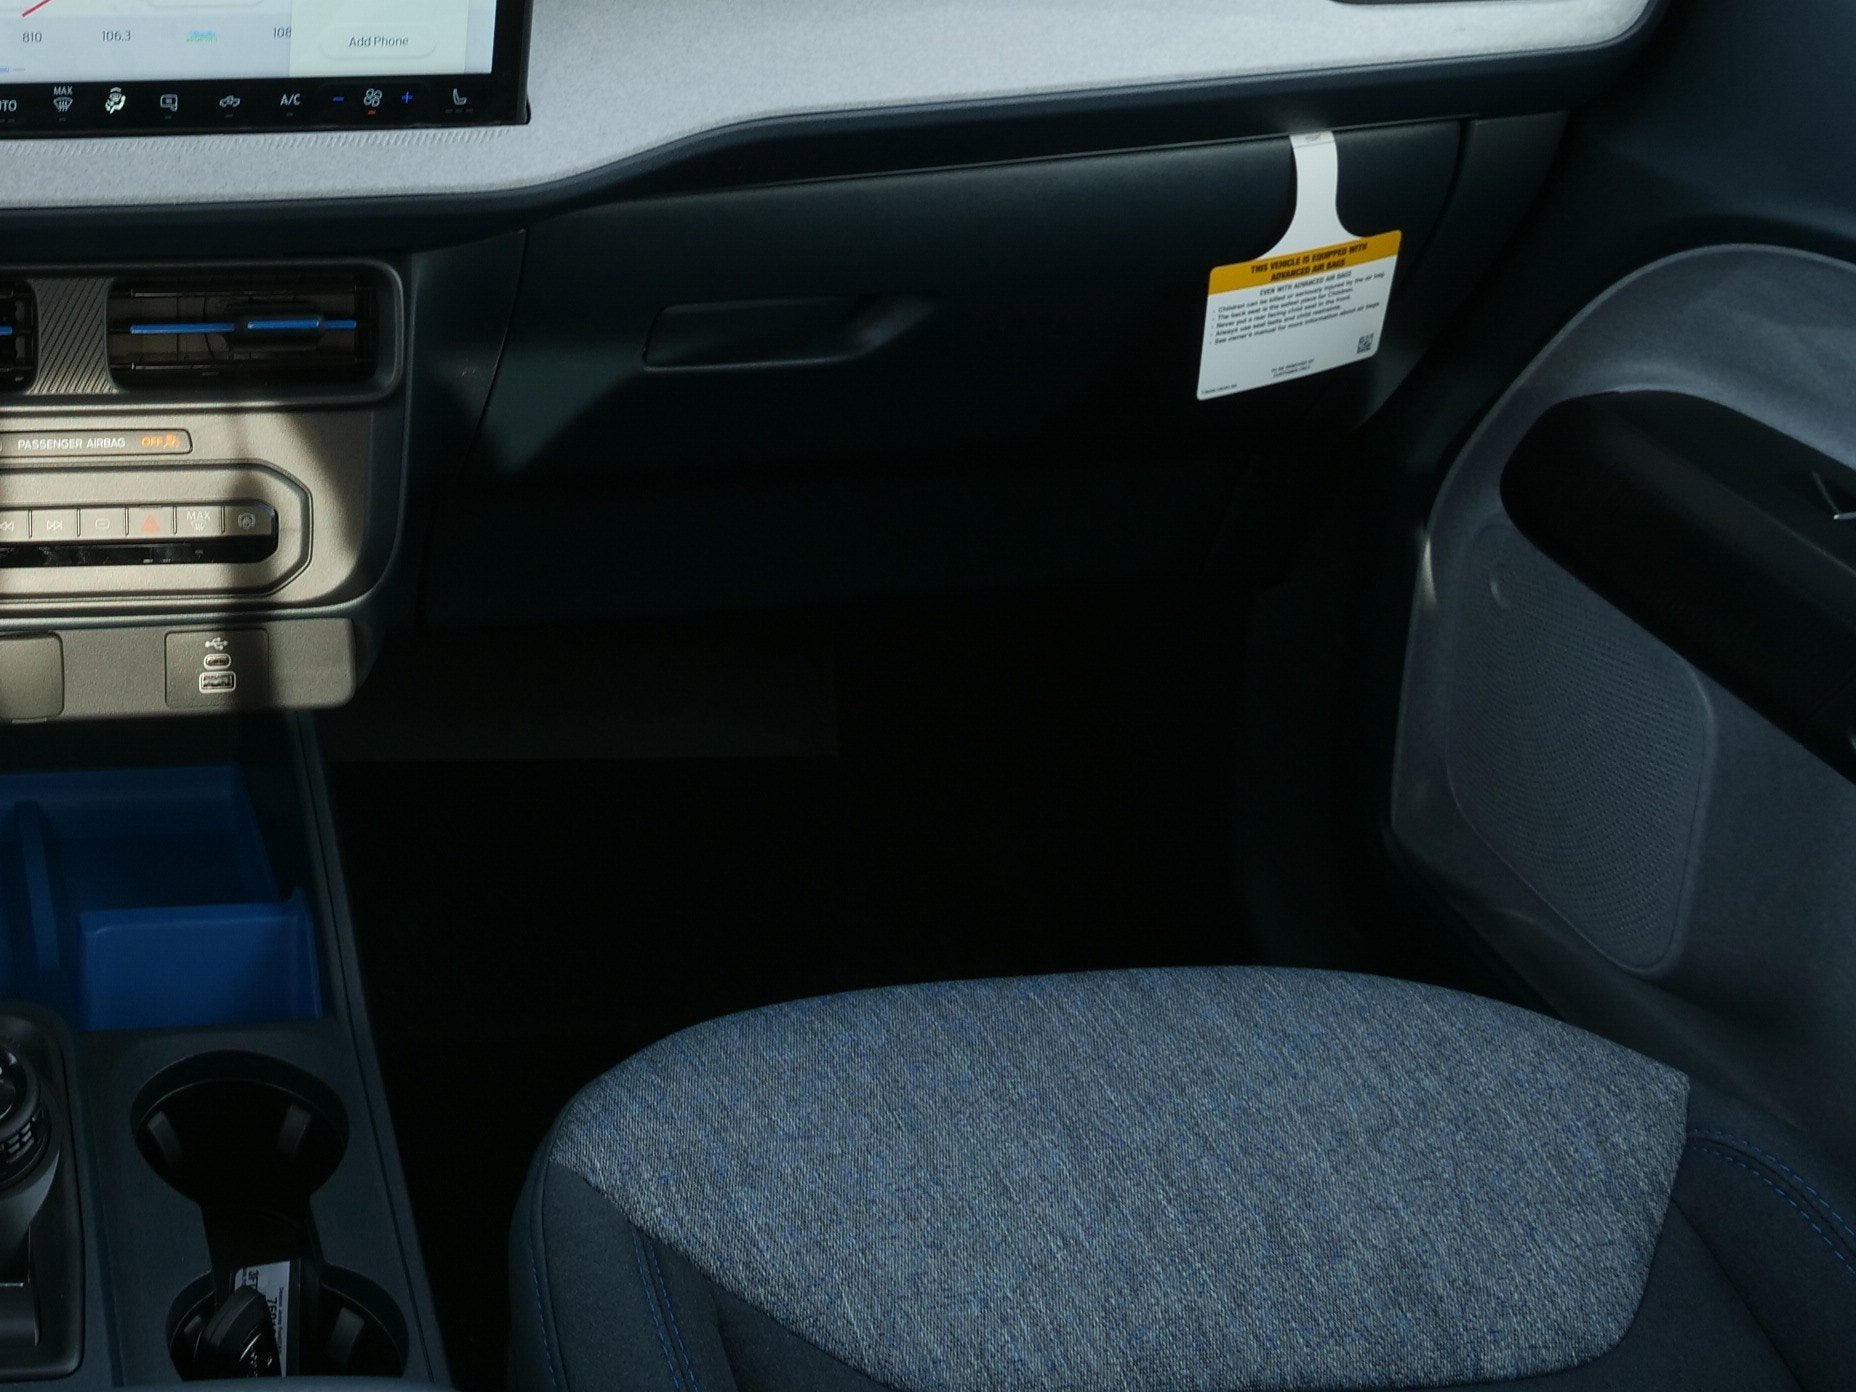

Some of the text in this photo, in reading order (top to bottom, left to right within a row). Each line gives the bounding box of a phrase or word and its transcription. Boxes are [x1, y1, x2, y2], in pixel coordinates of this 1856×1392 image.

[22, 32, 42, 43] 810
[101, 30, 131, 42] 106.3
[349, 35, 409, 48] Add Phone
[53, 86, 73, 96] MAX
[280, 93, 301, 107] A/C
[1251, 242, 1368, 274] THIS VEHICLE IS EQUIPPED WITH
[1270, 259, 1346, 281] ADVANCED AIR BAGS
[1259, 287, 1275, 296] EVEN
[1276, 283, 1292, 292] WITH
[17, 436, 126, 451] PASSENGER AIRBAG
[141, 436, 163, 448] OFF
[187, 510, 211, 521] MAX
